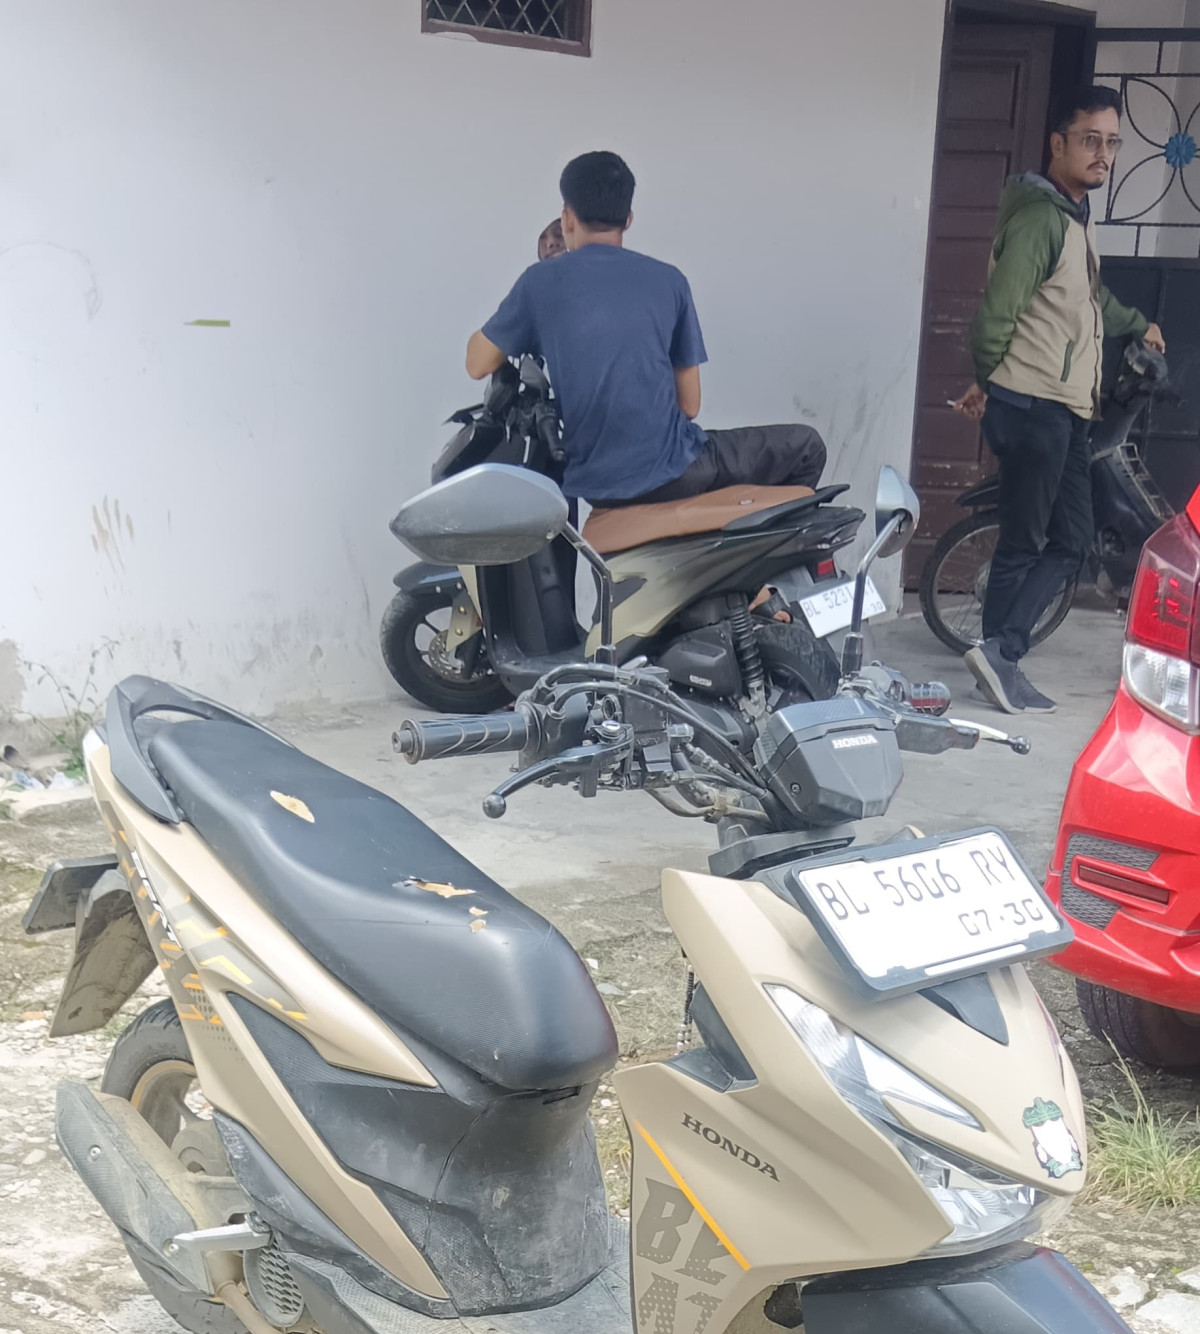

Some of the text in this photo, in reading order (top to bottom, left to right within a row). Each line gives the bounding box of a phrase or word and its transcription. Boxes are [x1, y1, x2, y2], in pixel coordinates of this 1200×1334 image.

[802, 599, 821, 618] BL
[831, 734, 879, 750] HONDA
[816, 846, 1016, 921] BL 5606 RY
[681, 1112, 781, 1182] HONDA
